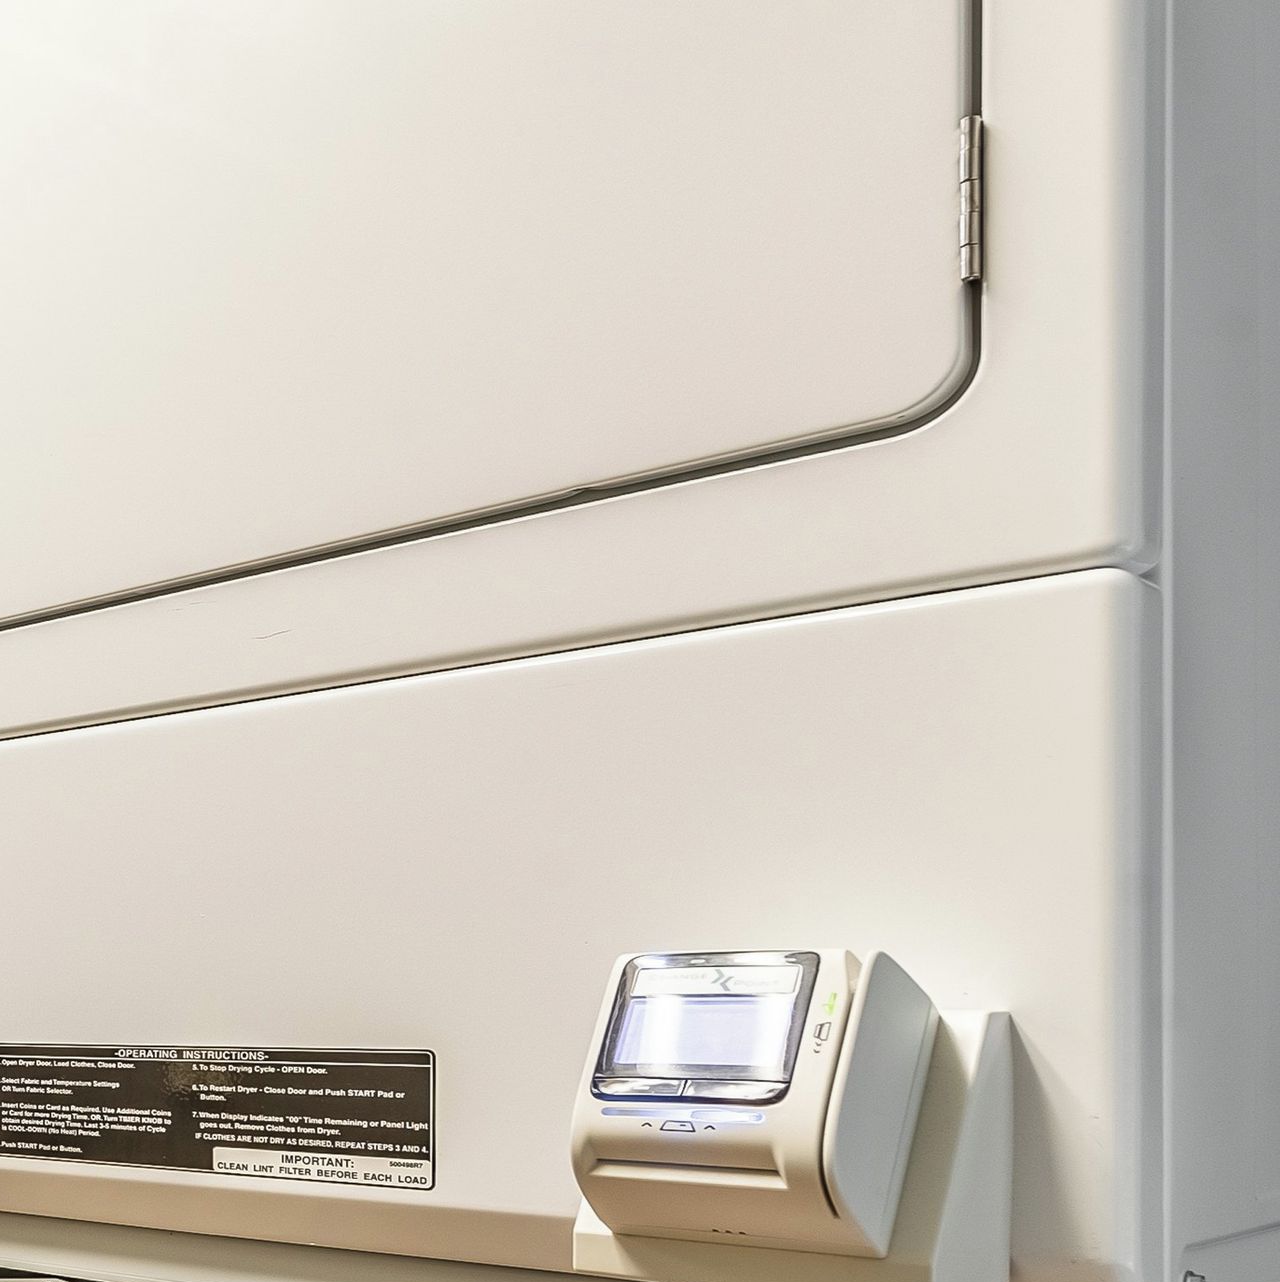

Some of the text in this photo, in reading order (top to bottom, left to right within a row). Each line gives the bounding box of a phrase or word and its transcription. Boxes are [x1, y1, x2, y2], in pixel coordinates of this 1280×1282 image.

[198, 1064, 208, 1072] To
[209, 1064, 227, 1074] Stop
[227, 1064, 252, 1074] Drying
[253, 1065, 275, 1075] Cycle
[280, 1066, 304, 1074] OPEN
[198, 1084, 208, 1093] To
[209, 1085, 236, 1094] Restart
[236, 1086, 258, 1096] Dryer
[263, 1087, 286, 1096] Close
[286, 1087, 306, 1096] Door
[307, 1088, 323, 1097] and
[324, 1089, 346, 1098] Push
[347, 1089, 375, 1098] START
[198, 1112, 219, 1120] When
[220, 1113, 248, 1123] Display
[249, 1114, 284, 1123] Indicates
[303, 1117, 323, 1125] Time
[324, 1118, 368, 1129] Remaining
[380, 1120, 404, 1129] Panel
[405, 1122, 428, 1132] Light
[199, 1122, 341, 1136] goes Remove Clothes from Dryer.
[202, 1133, 235, 1143] CLOTHES
[236, 1135, 252, 1144] ARE
[252, 1136, 268, 1145] NOT
[269, 1137, 285, 1146] DRY
[286, 1138, 297, 1146] AS
[334, 1140, 366, 1150] REPEAT
[366, 1142, 394, 1152] STEPS
[401, 1144, 420, 1153] AND
[282, 1154, 354, 1168] IMPORTANT:
[216, 1161, 427, 1185] CLEAN LINT FILTER BEFORE EACH LOAD
